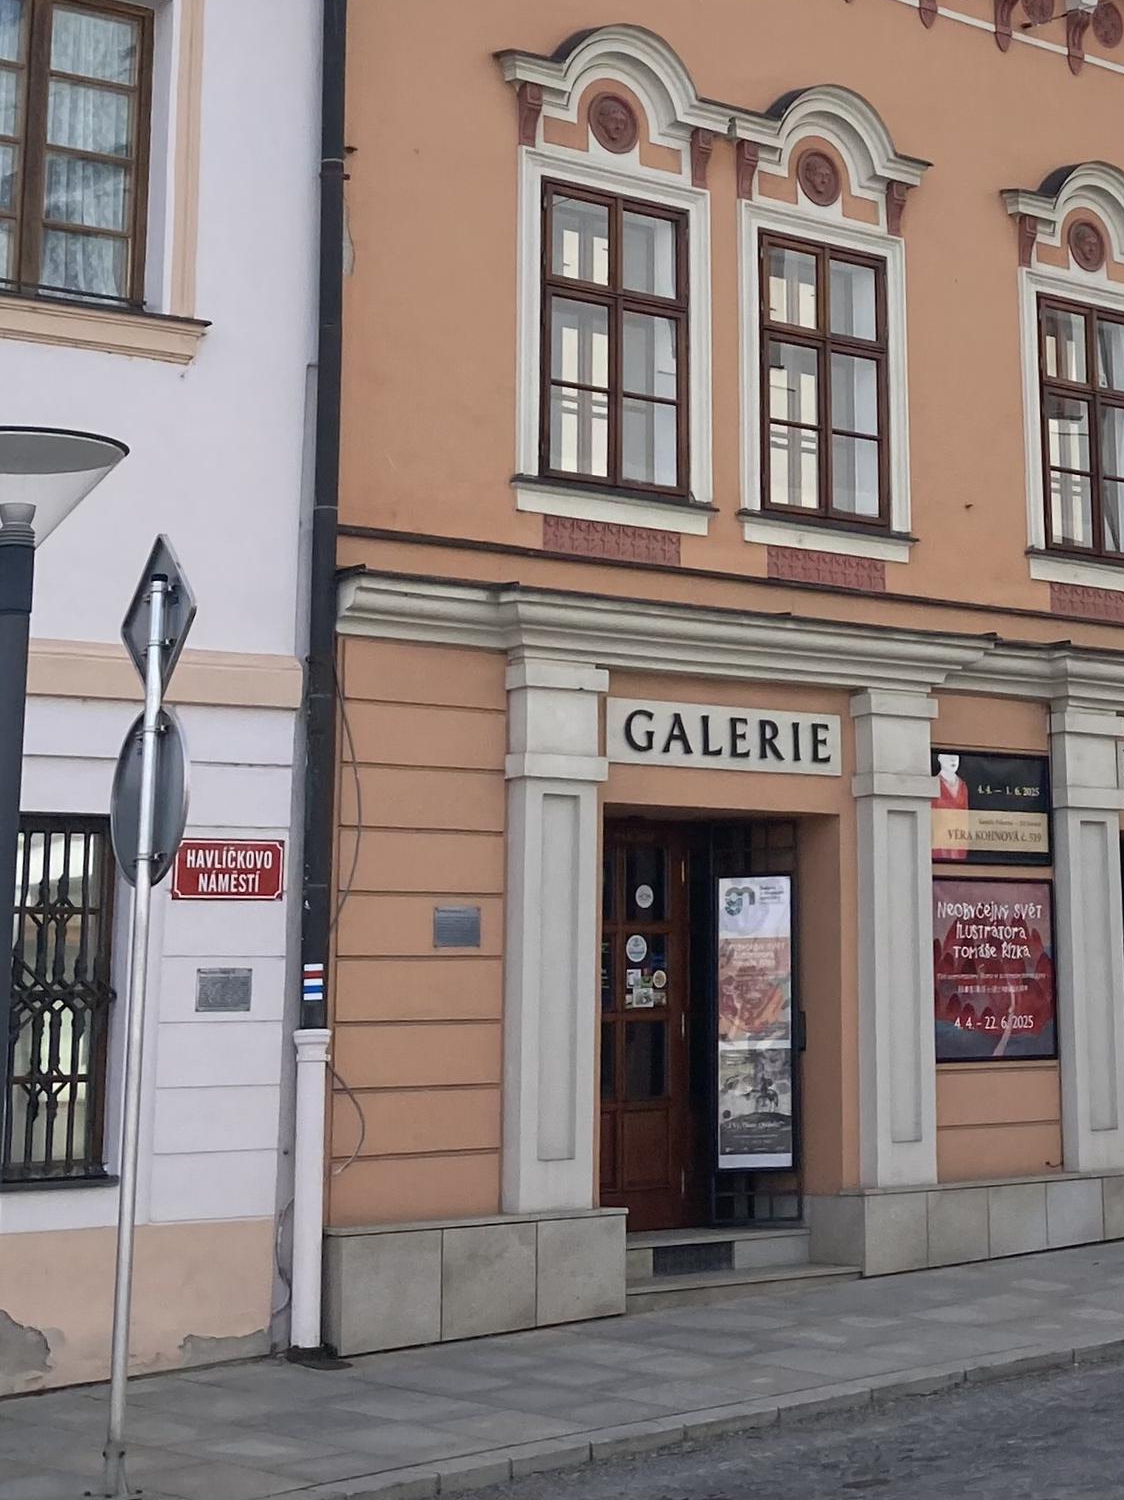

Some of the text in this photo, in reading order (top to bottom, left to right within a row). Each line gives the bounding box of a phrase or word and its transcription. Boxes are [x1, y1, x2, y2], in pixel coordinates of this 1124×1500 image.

[624, 709, 831, 763] GALERIE
[1023, 786, 1040, 797] 2025
[186, 846, 273, 869] HAVLÍČKOVO
[198, 870, 260, 893] NÁMĚSTÍ
[1012, 1014, 1034, 1029] 2025
